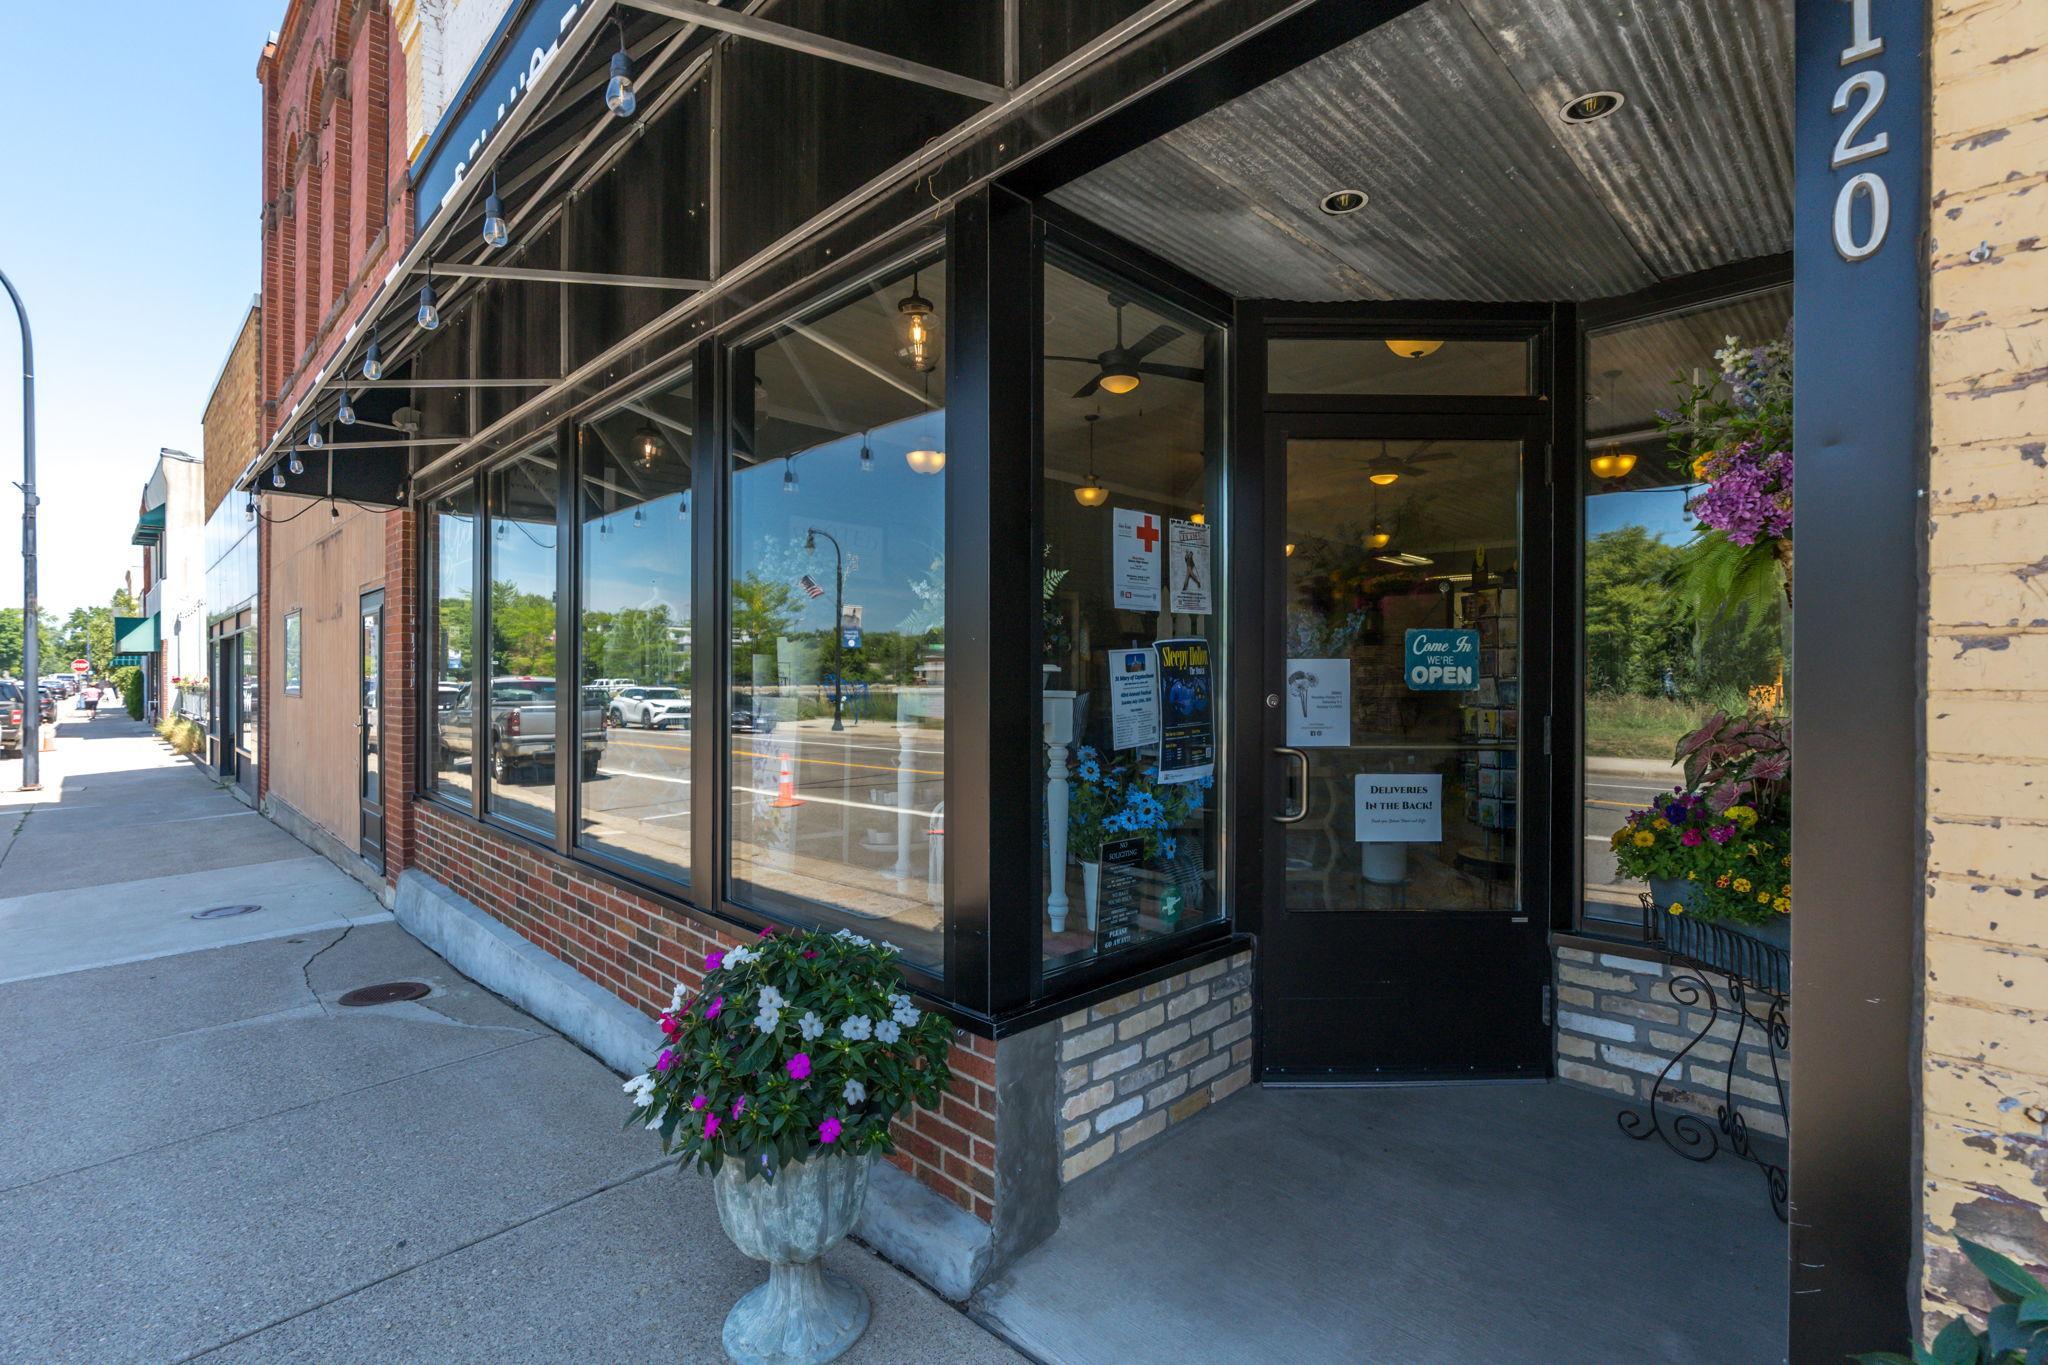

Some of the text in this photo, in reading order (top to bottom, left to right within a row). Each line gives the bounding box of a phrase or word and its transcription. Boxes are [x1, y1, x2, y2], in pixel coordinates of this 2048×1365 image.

[1413, 634, 1473, 655] Come In
[1427, 655, 1455, 665] WE'RE
[1411, 665, 1473, 685] OPEN
[1370, 785, 1429, 795] DELIVERIES
[1365, 801, 1433, 810] IN THE BACK!
[1119, 841, 1129, 849] NO
[1109, 849, 1138, 860] SOLICITING
